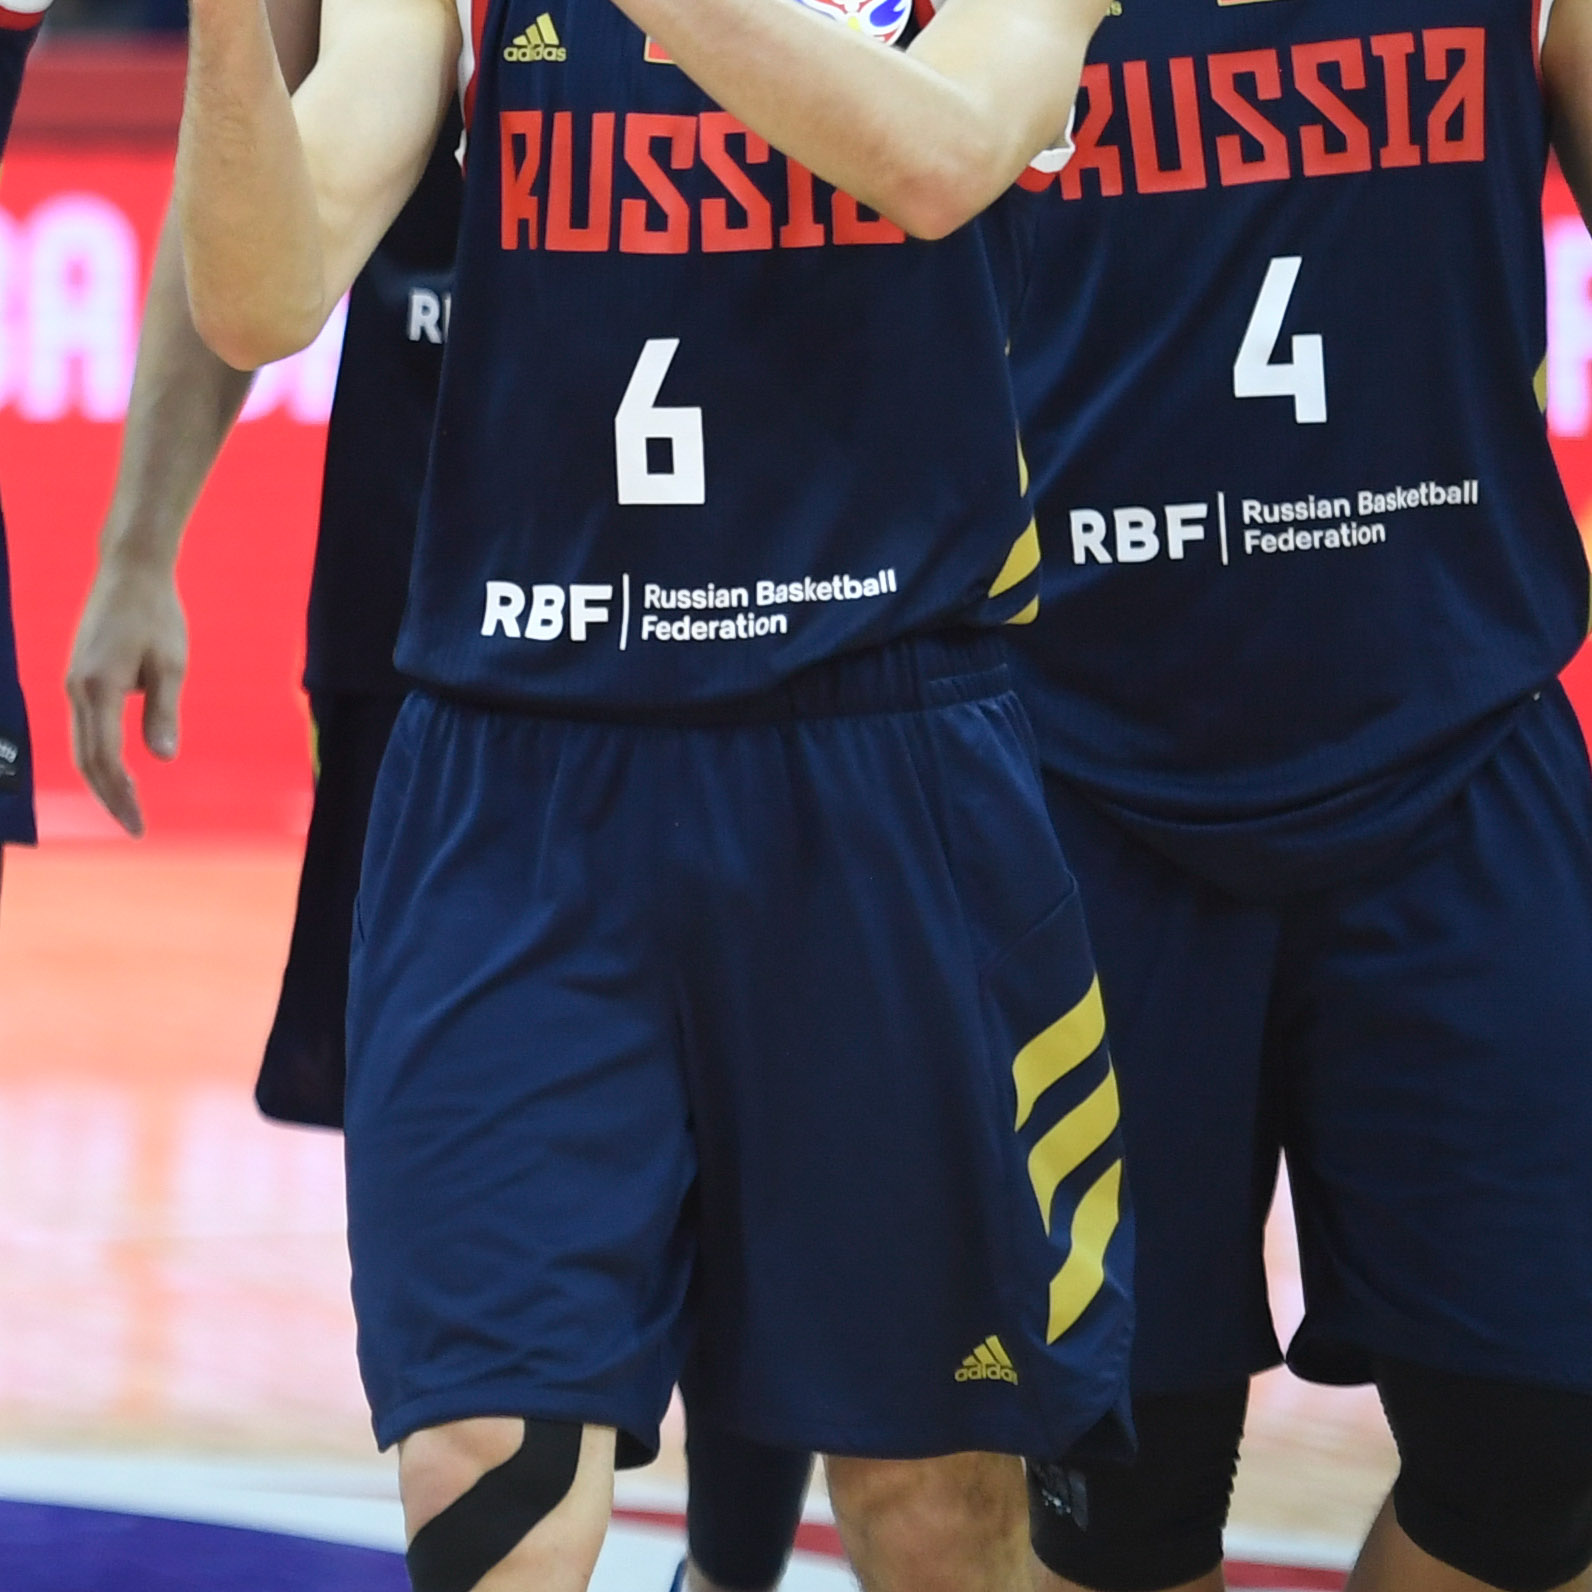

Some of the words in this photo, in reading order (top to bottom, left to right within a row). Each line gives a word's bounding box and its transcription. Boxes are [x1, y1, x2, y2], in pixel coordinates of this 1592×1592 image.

[1061, 26, 1487, 201] RUSSIA
[1232, 256, 1328, 424] 4
[613, 338, 706, 505] 6
[1242, 495, 1351, 525] Russian
[1357, 479, 1479, 516] Basketball
[1068, 502, 1209, 566] RBF
[1243, 518, 1386, 555] Federation
[480, 580, 613, 642] RBF
[644, 582, 749, 610] Russian
[756, 568, 897, 605] Basketball
[641, 612, 788, 641] Federation
